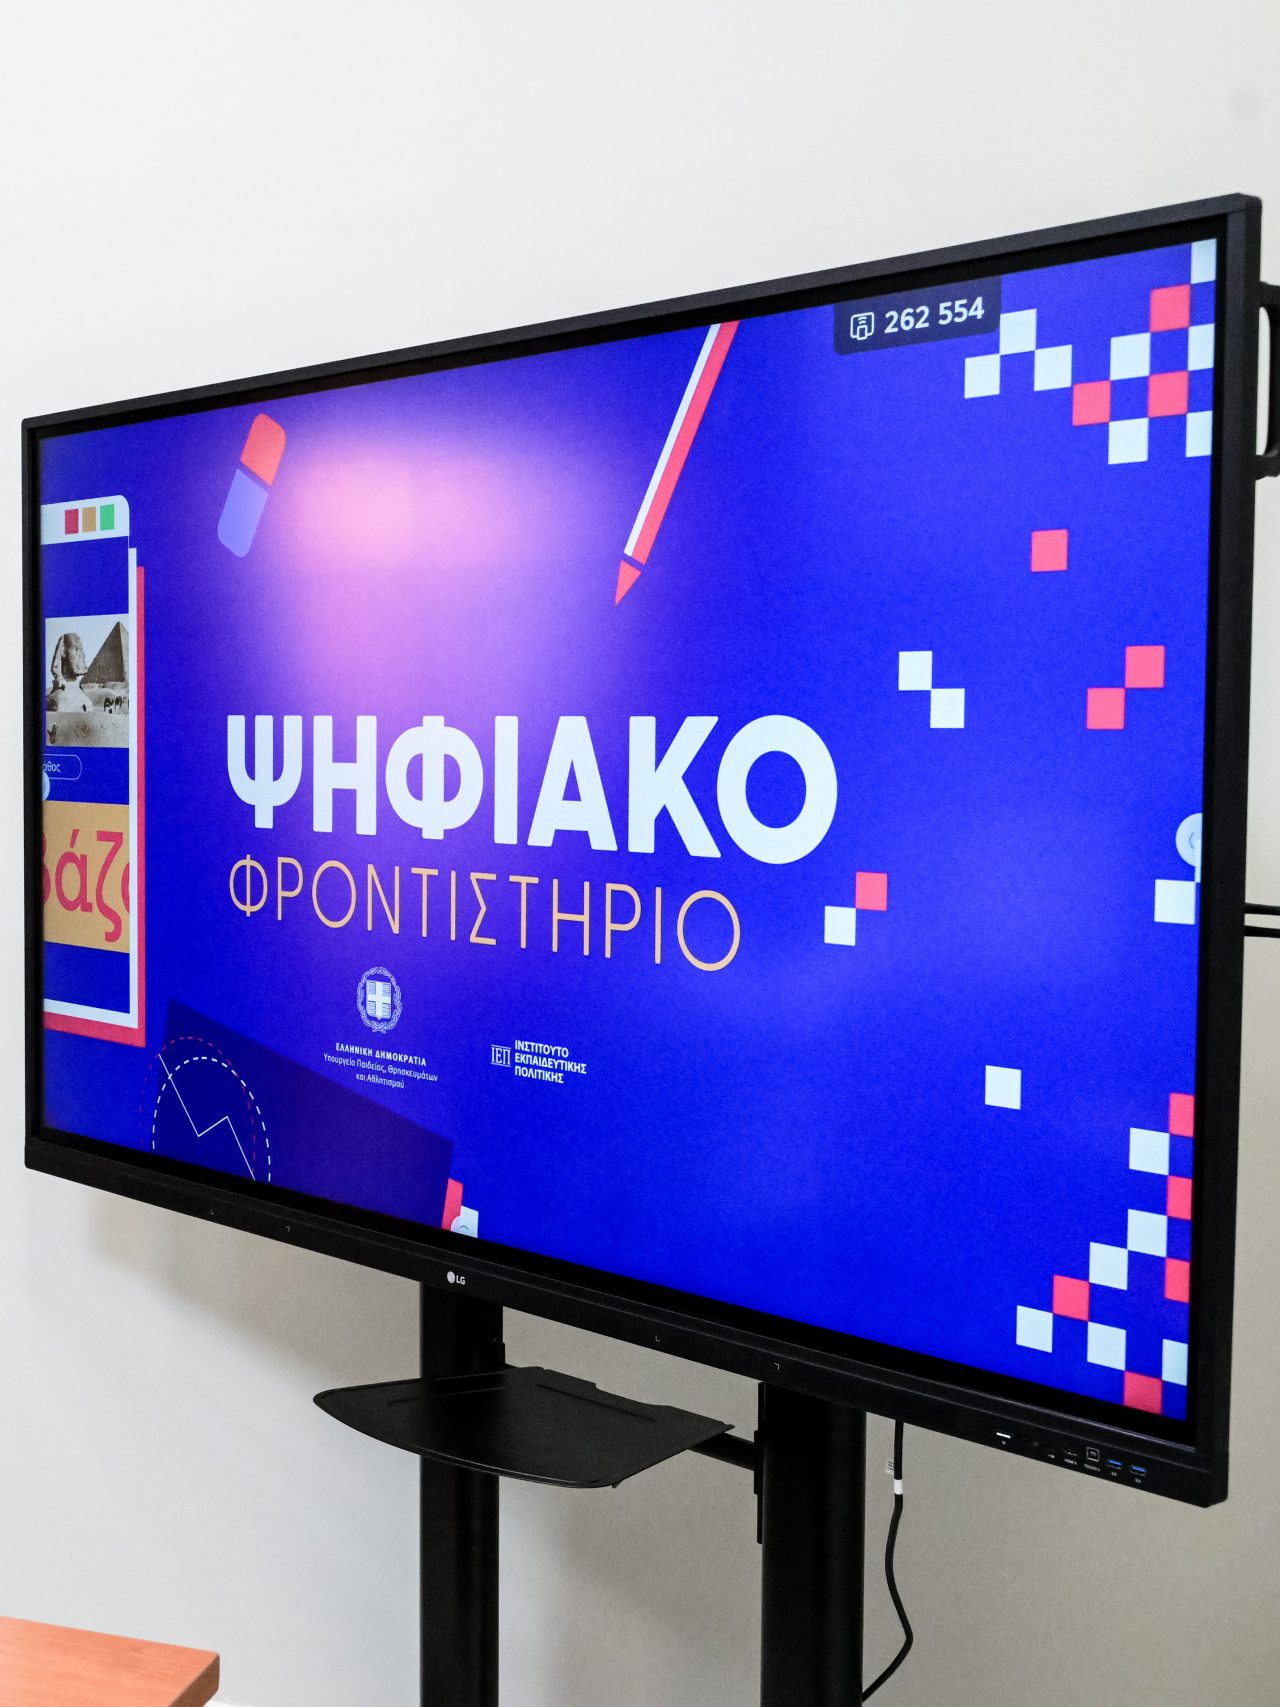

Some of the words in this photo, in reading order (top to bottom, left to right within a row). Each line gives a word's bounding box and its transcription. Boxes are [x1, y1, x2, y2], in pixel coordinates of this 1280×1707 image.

[883, 304, 930, 334] 262
[937, 296, 985, 326] 554
[226, 714, 839, 864] ΨΗΦΙΑΚΟ
[229, 854, 741, 972] ΦΡΟΝΤΙΣΤΗΡΙΟ
[335, 1042, 373, 1057] ΕΛΛΗΝΙΚΗ
[375, 1050, 427, 1066] ΔΗΜΟΚΡΑΤΙΑ
[514, 1040, 569, 1058] ΙΝΣΤΙΤΟΥΤΟ
[323, 1053, 356, 1068] Υπουργείο
[356, 1058, 387, 1074] Παιδείας,
[388, 1064, 439, 1082] Θρησκευμάτων
[514, 1052, 587, 1075] ΕΚΠΑΙΔΕΥΤΙΚΗΣ
[514, 1065, 565, 1084] ΠΟΛΙΤΙΚΗΣ
[355, 1072, 366, 1082] και
[366, 1074, 405, 1089] Αθλητισμού
[455, 1275, 466, 1285] LG
